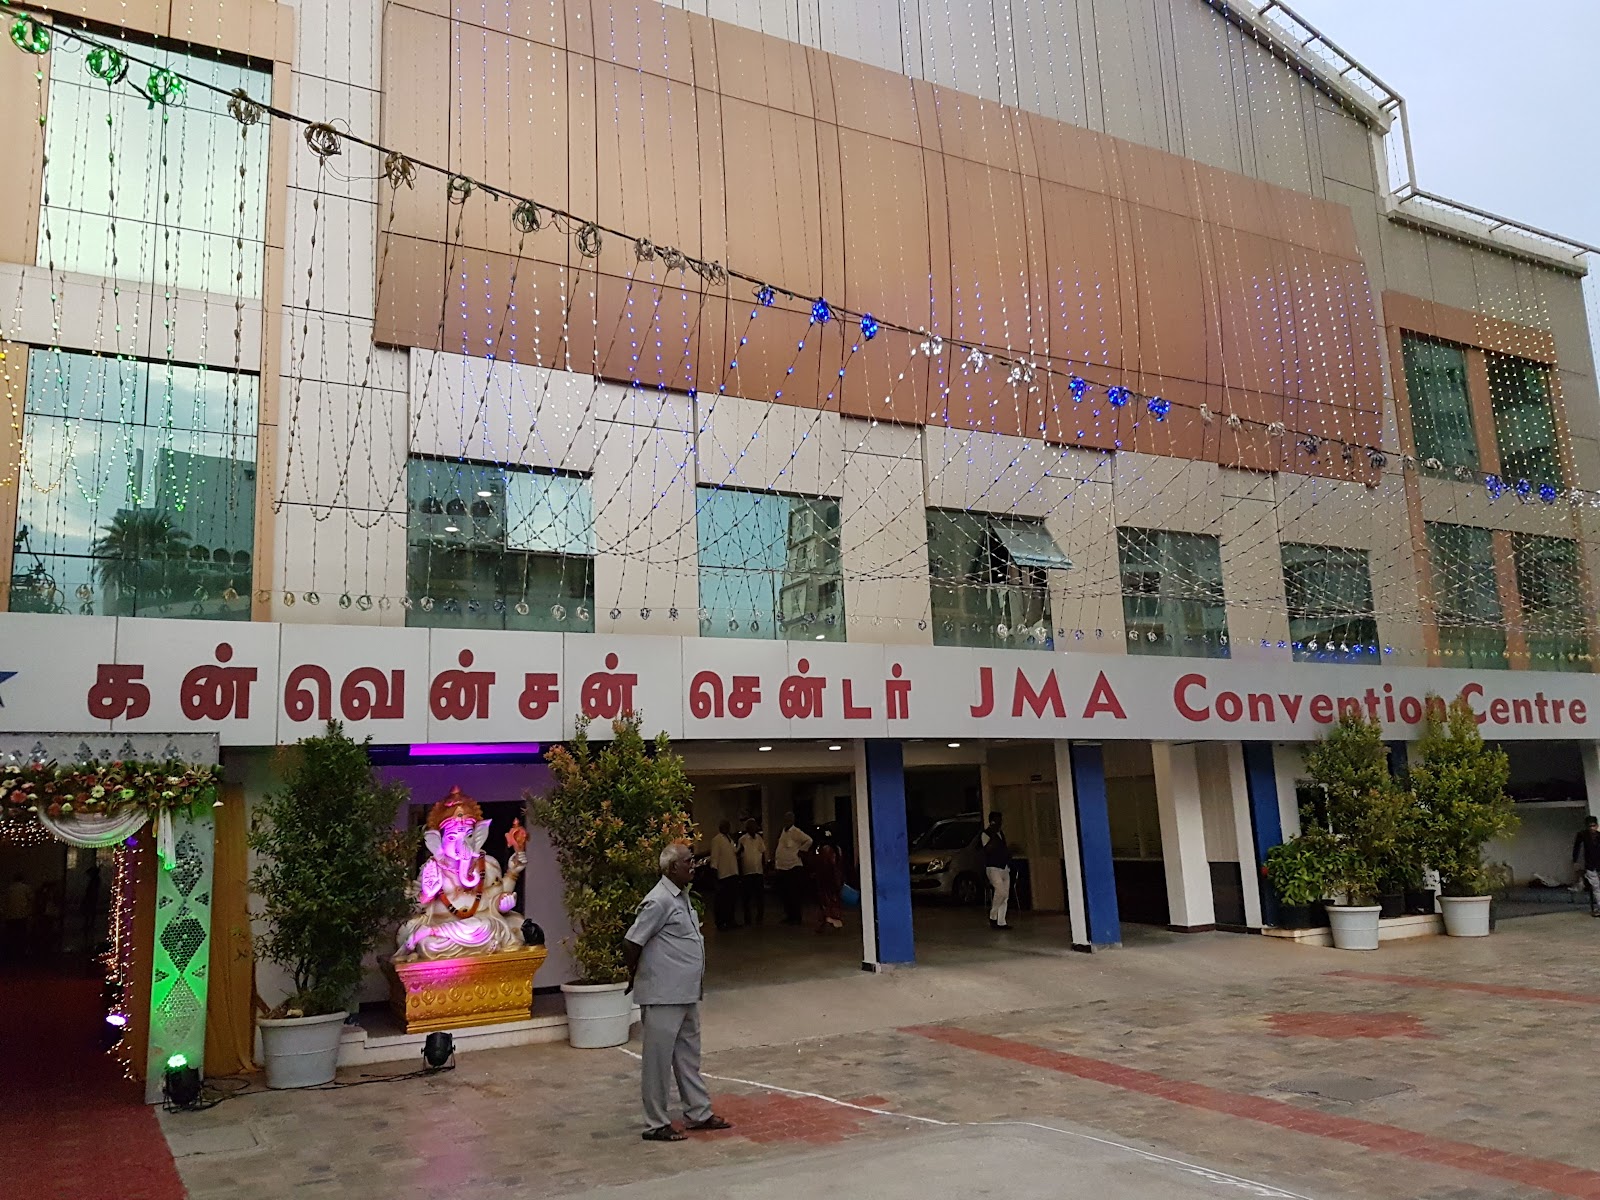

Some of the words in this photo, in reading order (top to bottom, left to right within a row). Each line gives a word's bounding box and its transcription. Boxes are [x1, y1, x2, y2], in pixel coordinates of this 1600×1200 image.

[689, 657, 914, 720] சென்டர்
[969, 667, 1127, 720] JMA
[1173, 671, 1448, 725] Convention
[1460, 681, 1587, 724] Centre
